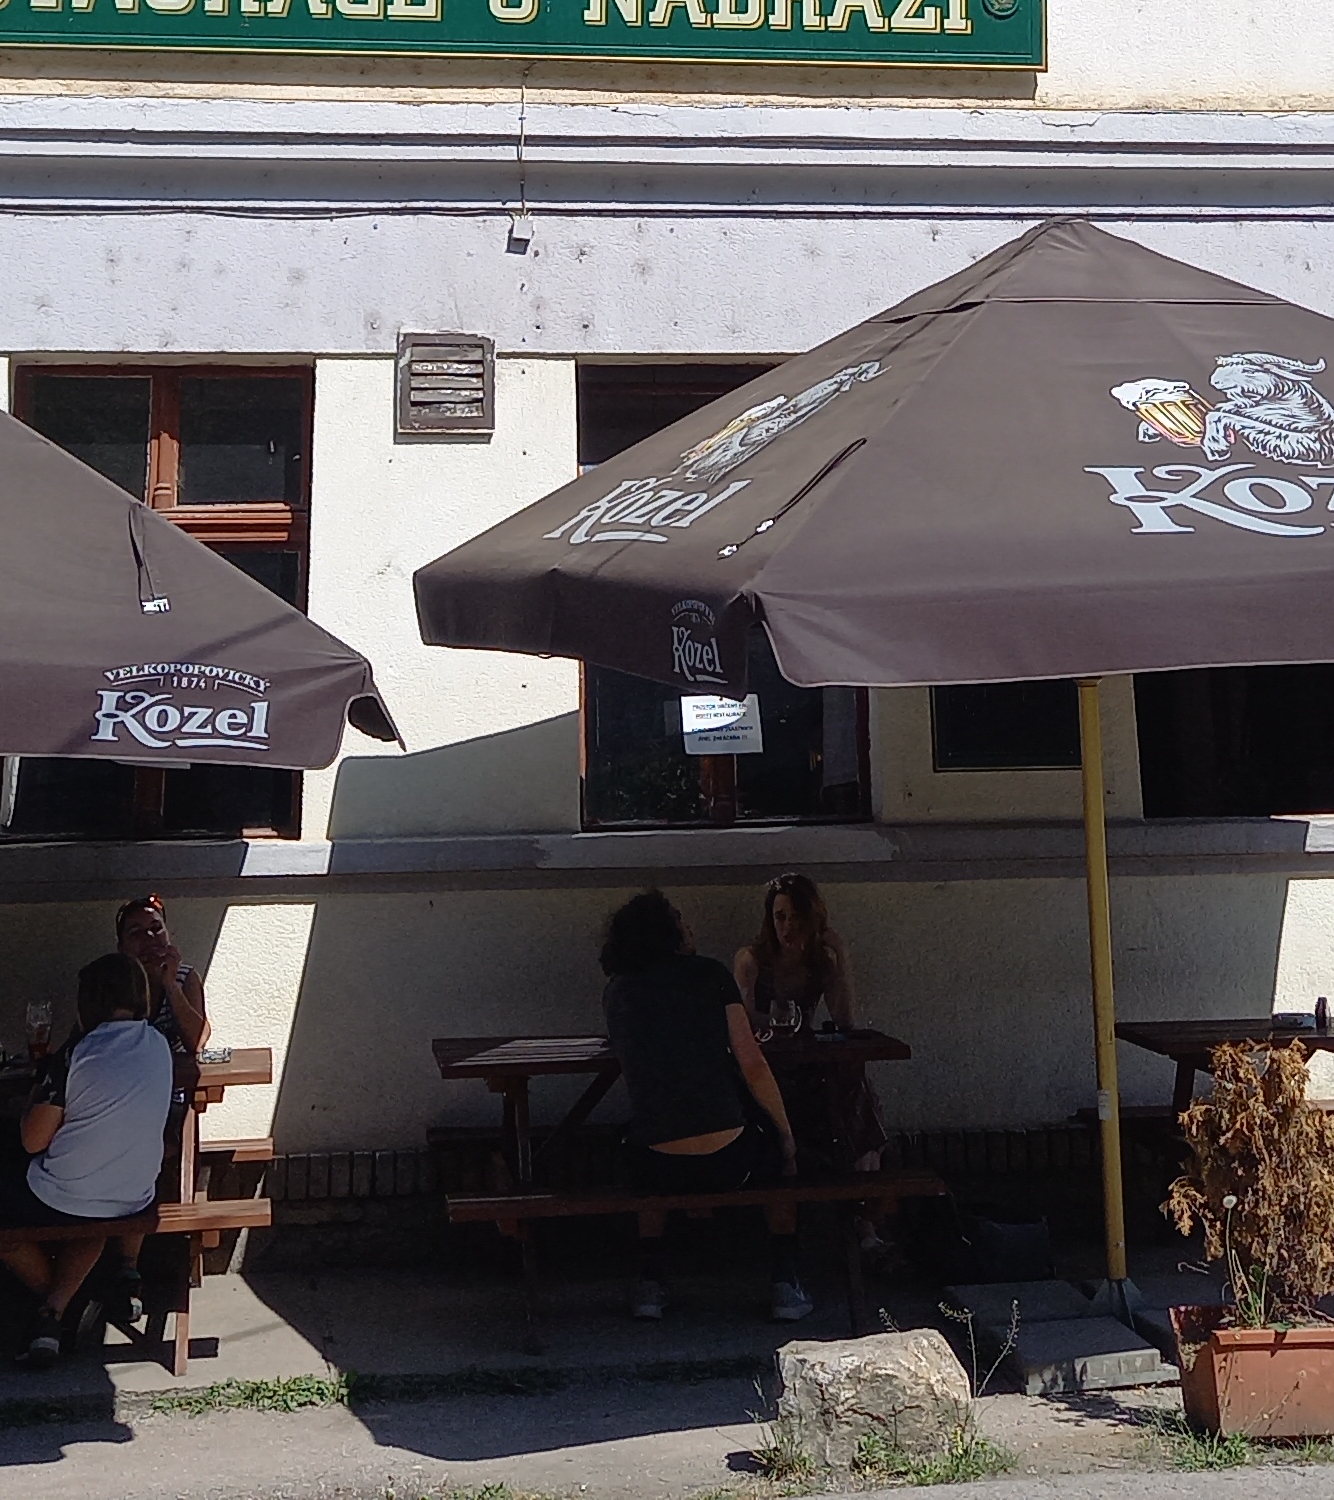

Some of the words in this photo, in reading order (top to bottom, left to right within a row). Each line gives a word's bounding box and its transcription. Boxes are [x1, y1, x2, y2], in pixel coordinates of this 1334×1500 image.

[542, 477, 753, 545] Kozel
[171, 675, 207, 690] 1874
[671, 626, 727, 682] Kozel
[90, 690, 270, 750] Kozel
